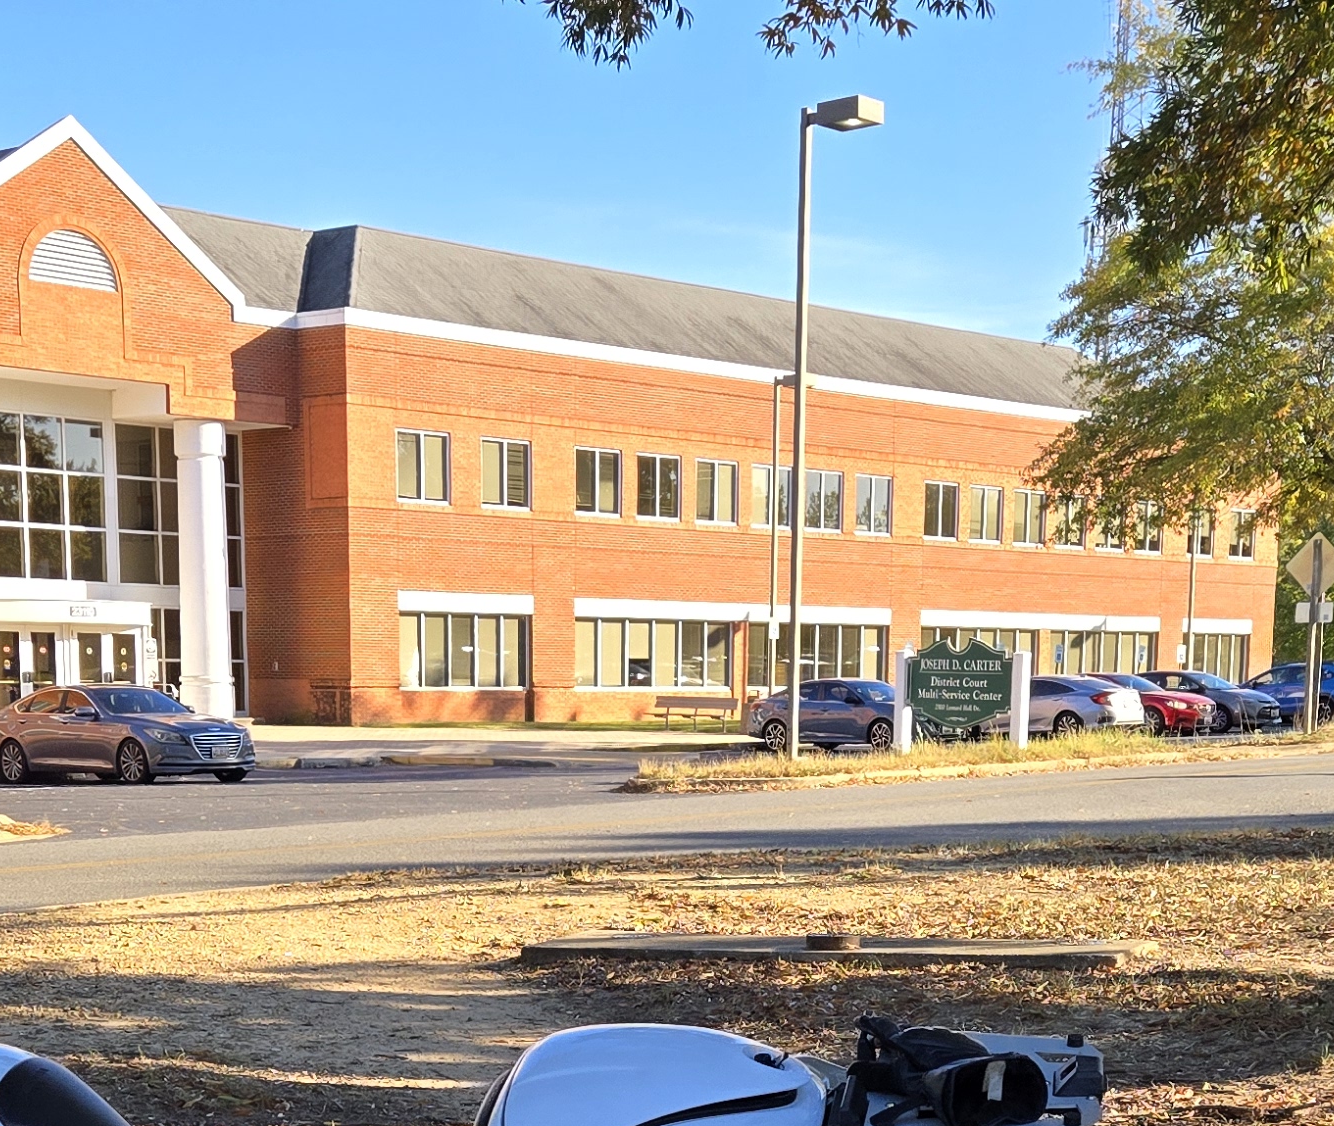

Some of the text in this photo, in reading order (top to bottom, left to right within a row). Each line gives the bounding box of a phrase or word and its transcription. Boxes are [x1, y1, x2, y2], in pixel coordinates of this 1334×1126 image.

[920, 658, 1002, 671] JOSEPH D. CARTER
[930, 676, 988, 688] District Court
[918, 688, 1003, 701] Multi-Service Center
